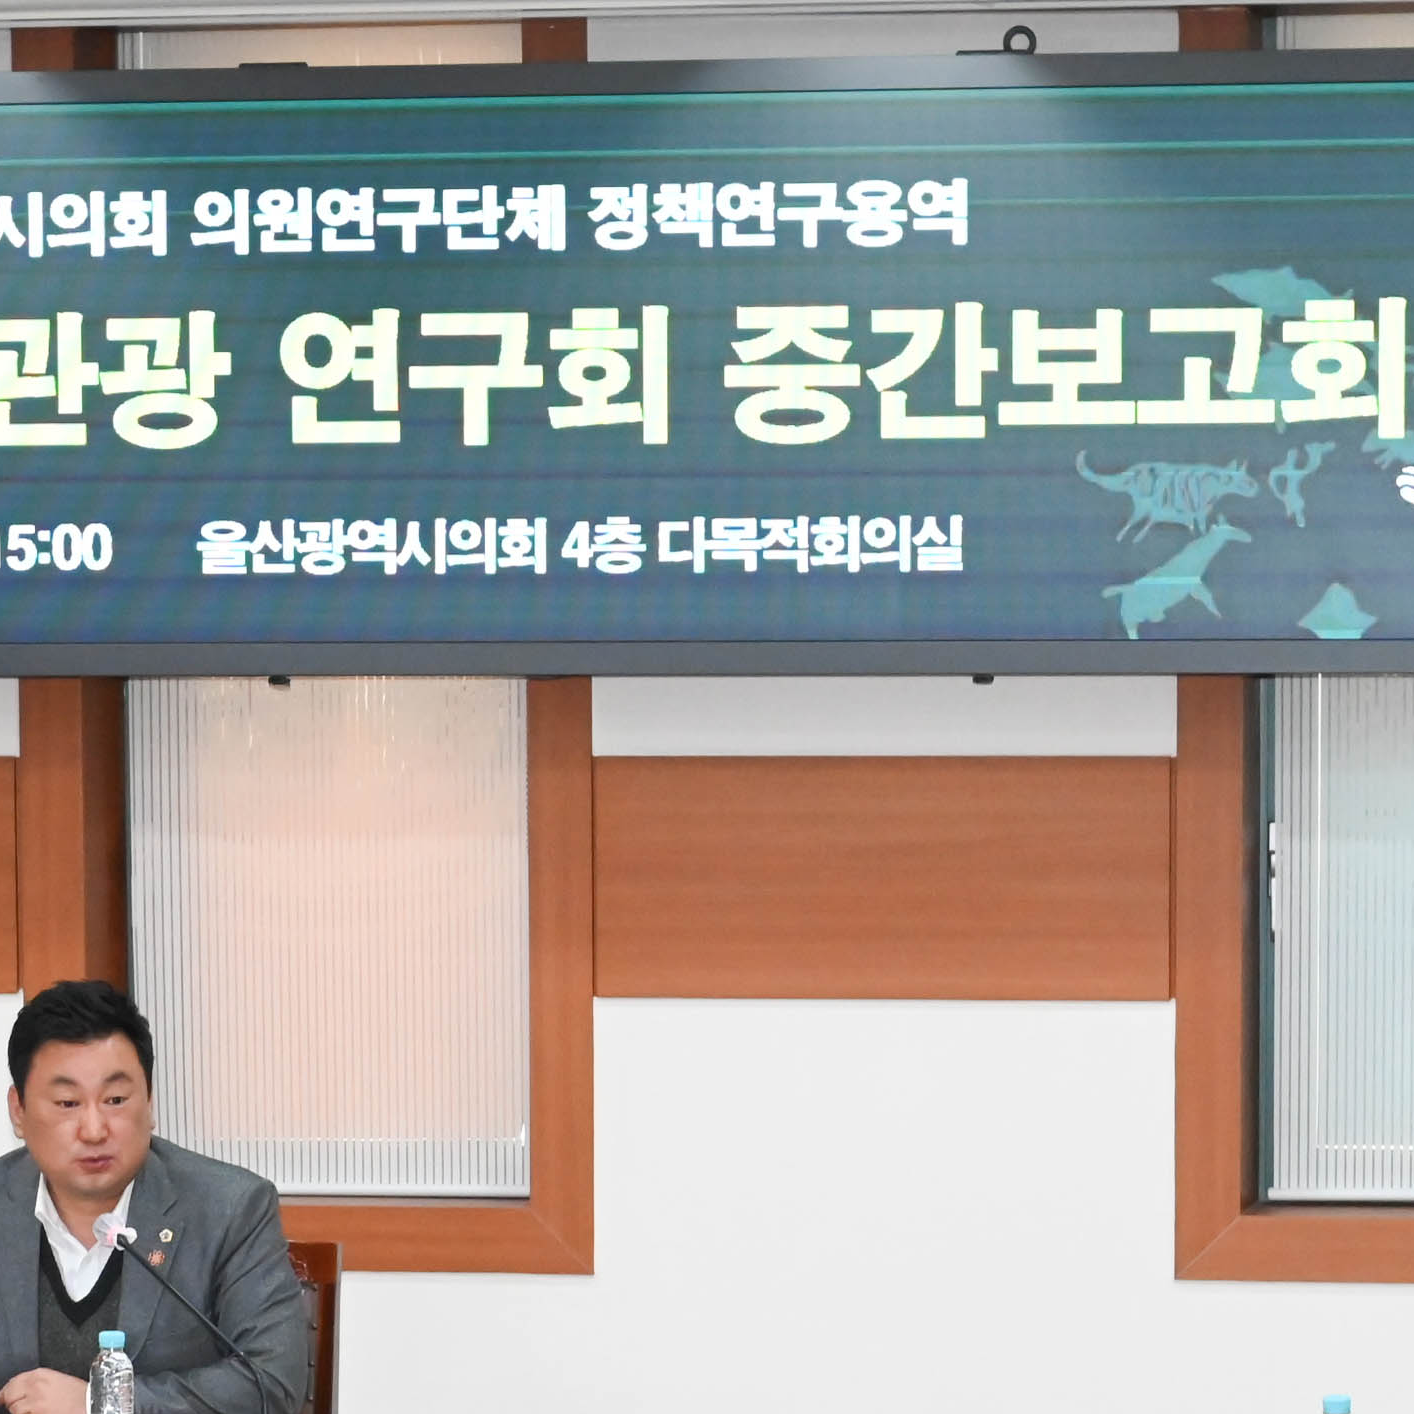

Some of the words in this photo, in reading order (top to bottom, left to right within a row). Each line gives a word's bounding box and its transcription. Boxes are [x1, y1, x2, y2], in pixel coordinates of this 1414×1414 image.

[191, 185, 565, 255] 의원연구단체
[588, 178, 968, 250] 정책연구용역
[280, 305, 669, 446] 연구회
[724, 297, 1407, 445] 중간보고회
[197, 518, 547, 575] 울산광역시의회
[562, 516, 646, 574] 4층
[658, 515, 963, 573] 다목적회의실
